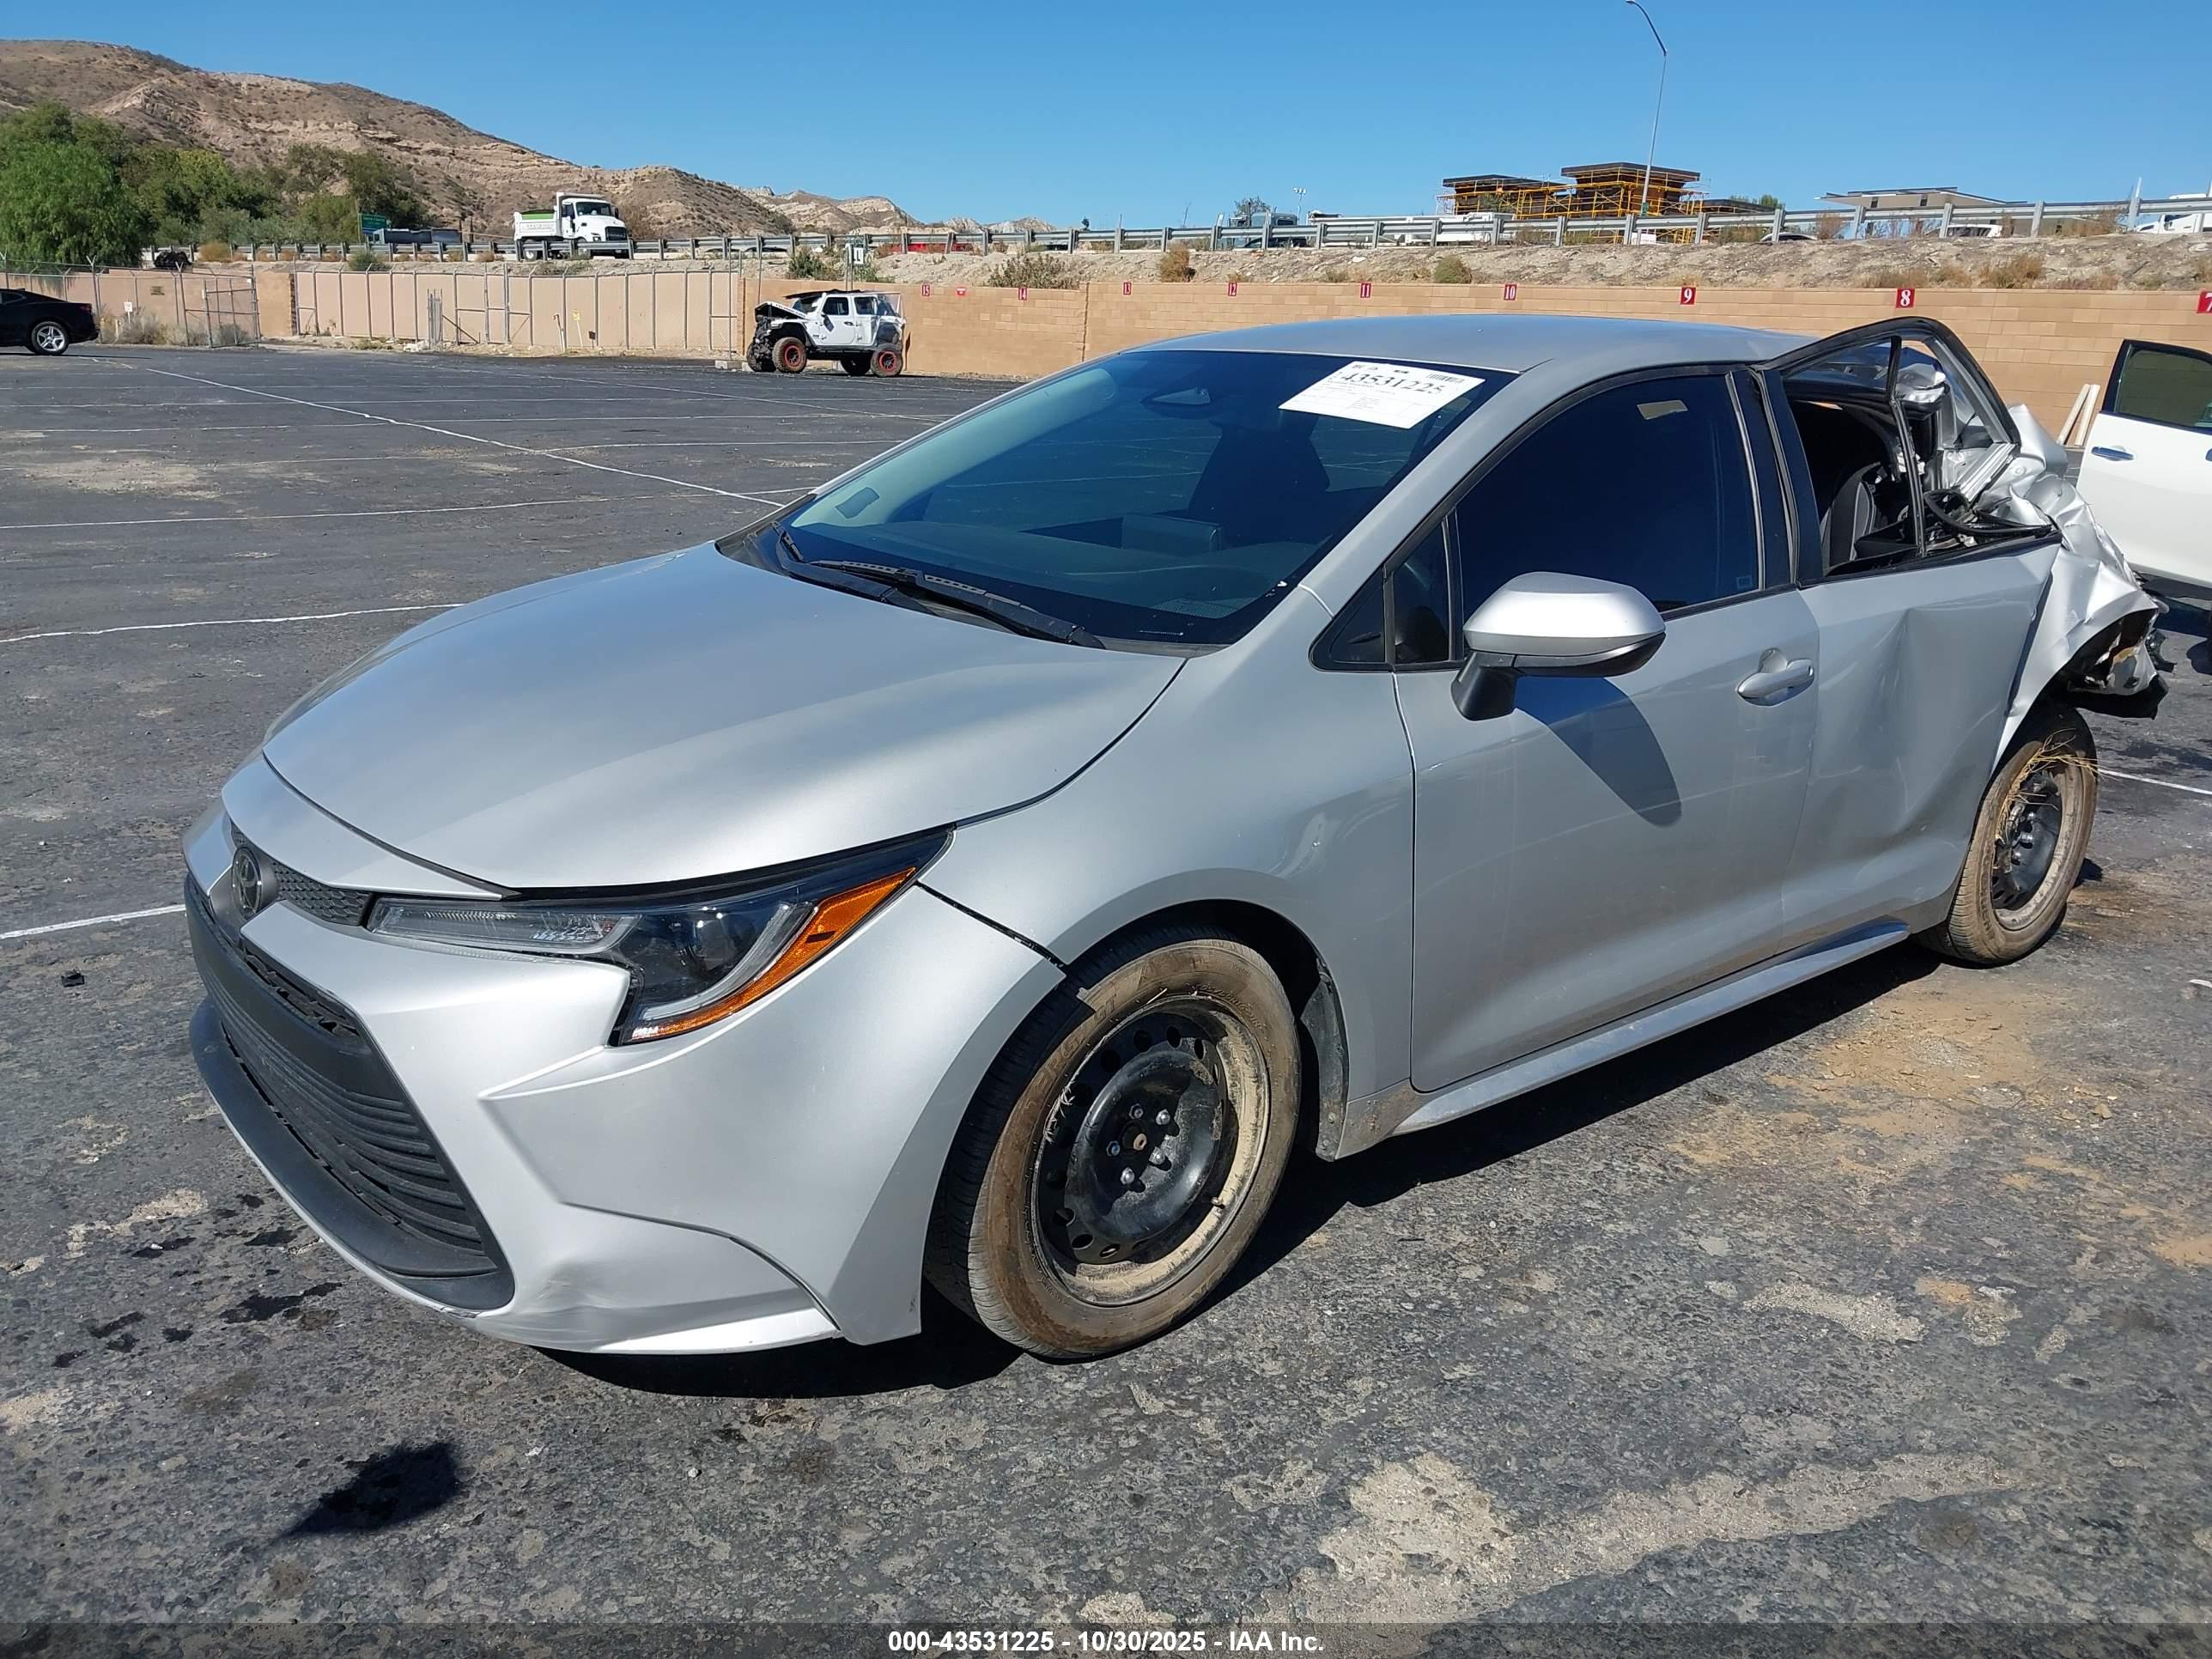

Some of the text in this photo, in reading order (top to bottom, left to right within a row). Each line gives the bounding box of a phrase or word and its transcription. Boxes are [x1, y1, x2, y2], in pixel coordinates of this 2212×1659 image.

[922, 284, 930, 296] 15
[1229, 283, 1237, 295] 12
[1361, 284, 1370, 297] 11
[1504, 285, 1516, 300] 10
[1682, 288, 1692, 304] 9
[1899, 289, 1911, 307] 8
[2204, 292, 2212, 312] 7
[1342, 373, 1445, 393] 43531225
